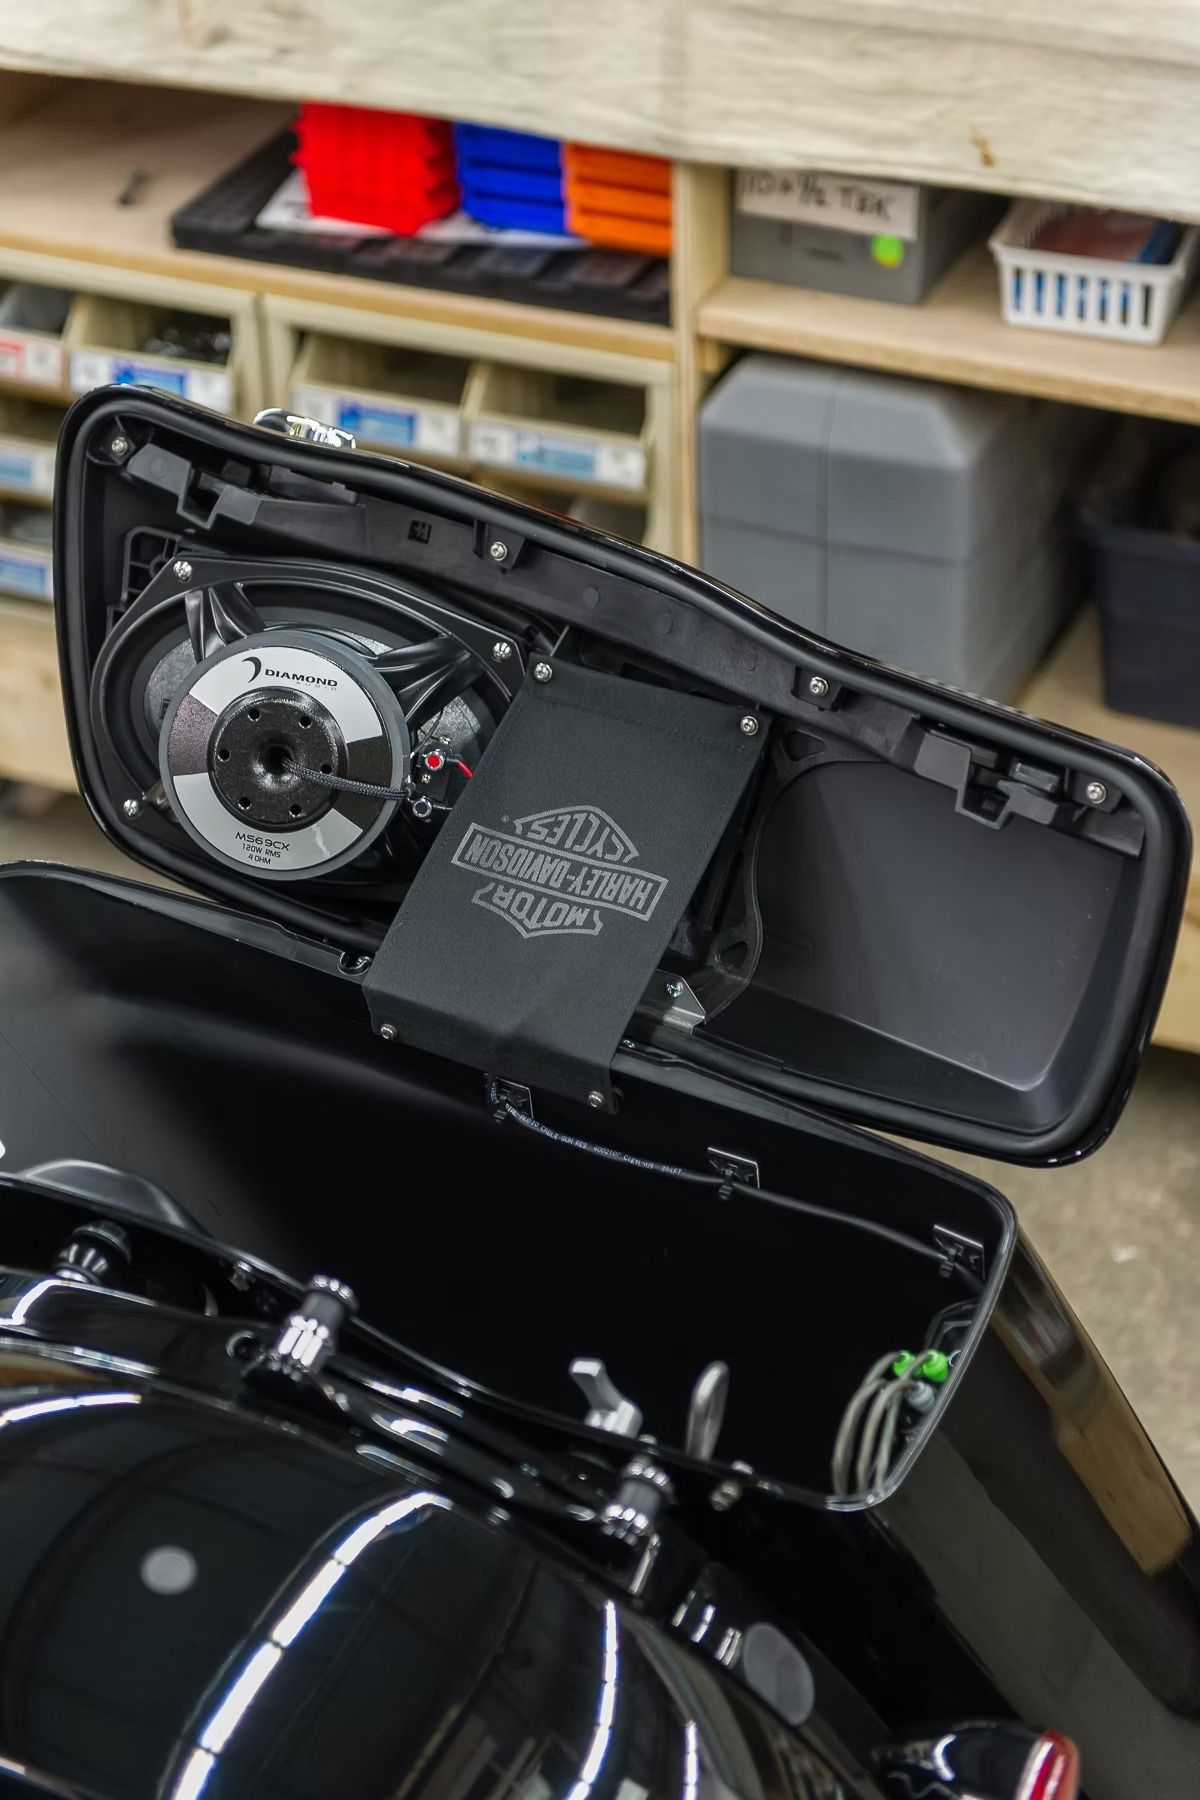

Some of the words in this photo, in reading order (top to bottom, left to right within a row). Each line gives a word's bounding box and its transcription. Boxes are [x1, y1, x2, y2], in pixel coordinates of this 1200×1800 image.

[264, 668, 338, 687] DIAMOND
[234, 832, 290, 852] MS69CX
[525, 811, 626, 862] CYCLES
[242, 842, 263, 854] 120W
[265, 848, 282, 859] RMS
[254, 855, 271, 865] OHM
[463, 833, 655, 910] HARLEY-DAVIDSON
[491, 885, 591, 931] MOTOR
